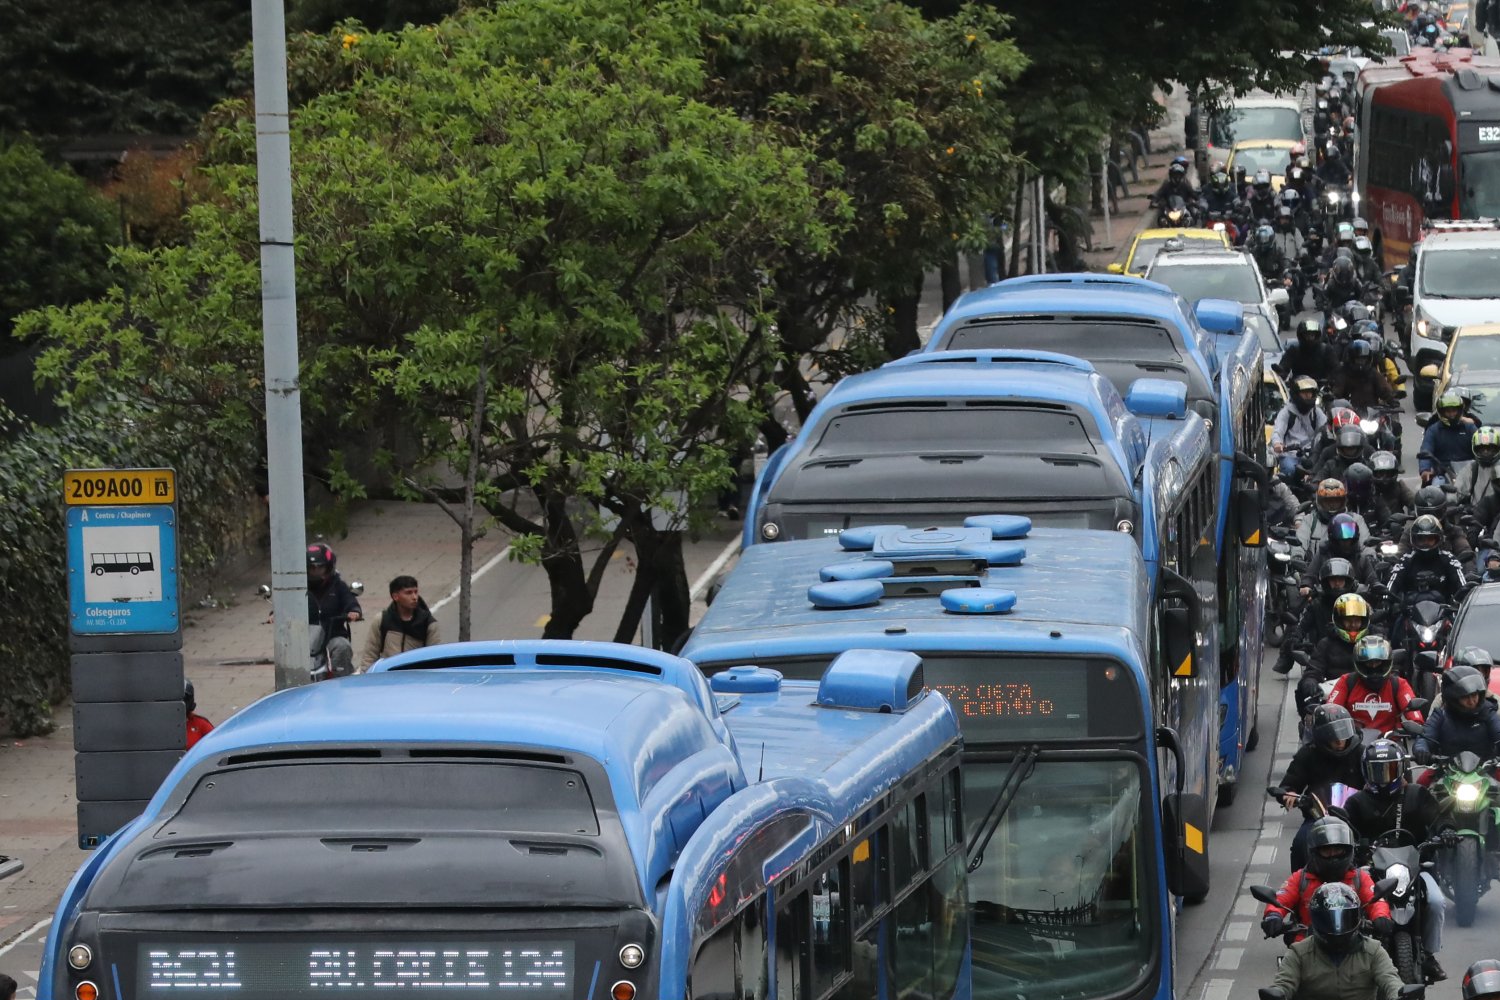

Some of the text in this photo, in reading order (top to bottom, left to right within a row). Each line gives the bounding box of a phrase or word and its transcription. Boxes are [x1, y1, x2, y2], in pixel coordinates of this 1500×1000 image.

[72, 478, 143, 498] 209A00
[157, 484, 166, 495] A
[81, 509, 89, 522] A
[121, 511, 151, 520] Chapinero
[86, 607, 131, 619] Colseguros
